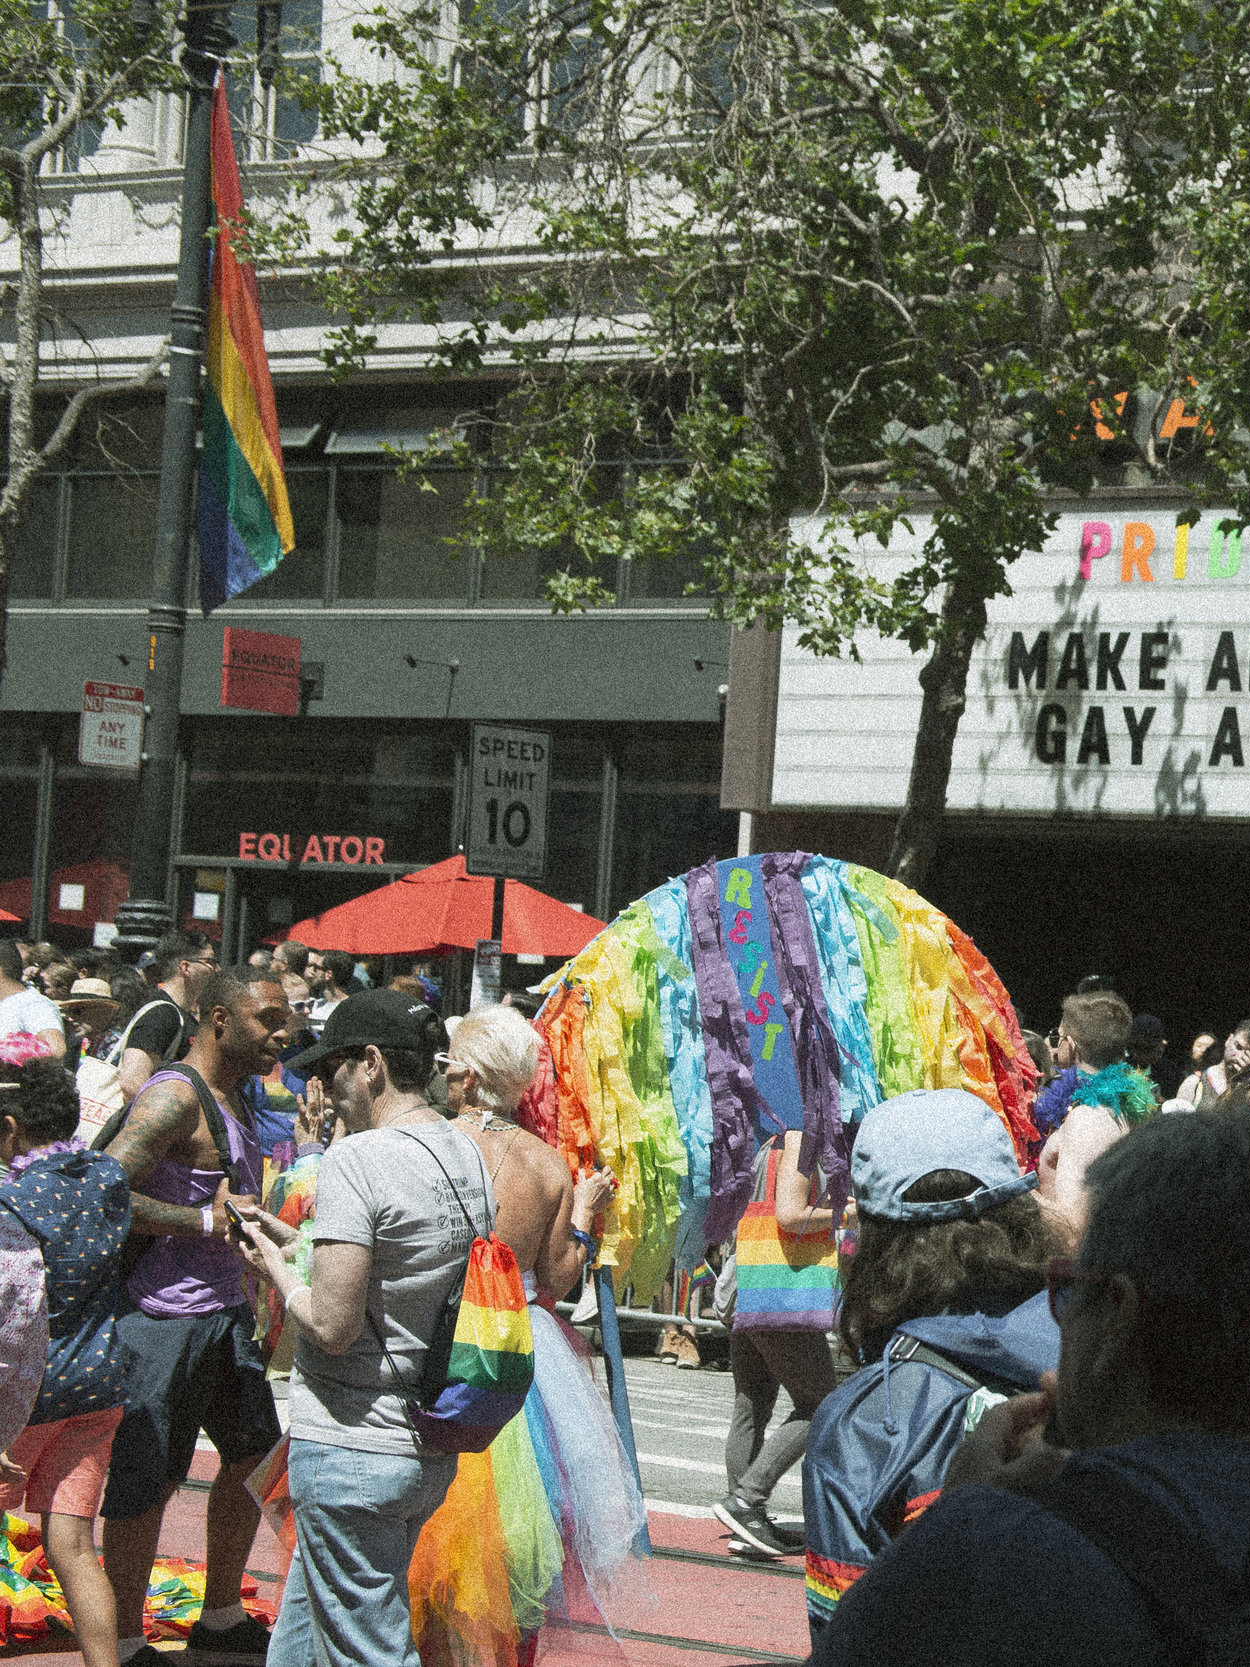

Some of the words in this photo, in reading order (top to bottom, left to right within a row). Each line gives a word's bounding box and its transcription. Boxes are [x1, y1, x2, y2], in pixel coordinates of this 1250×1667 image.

[1007, 631, 1170, 691] MAKE
[85, 694, 102, 711] NO
[99, 720, 126, 735] ANY
[1035, 703, 1156, 766] GAY
[96, 735, 128, 750] TIME
[478, 735, 545, 763] SPEED
[484, 766, 537, 791] LIMIT
[485, 797, 531, 848] 10
